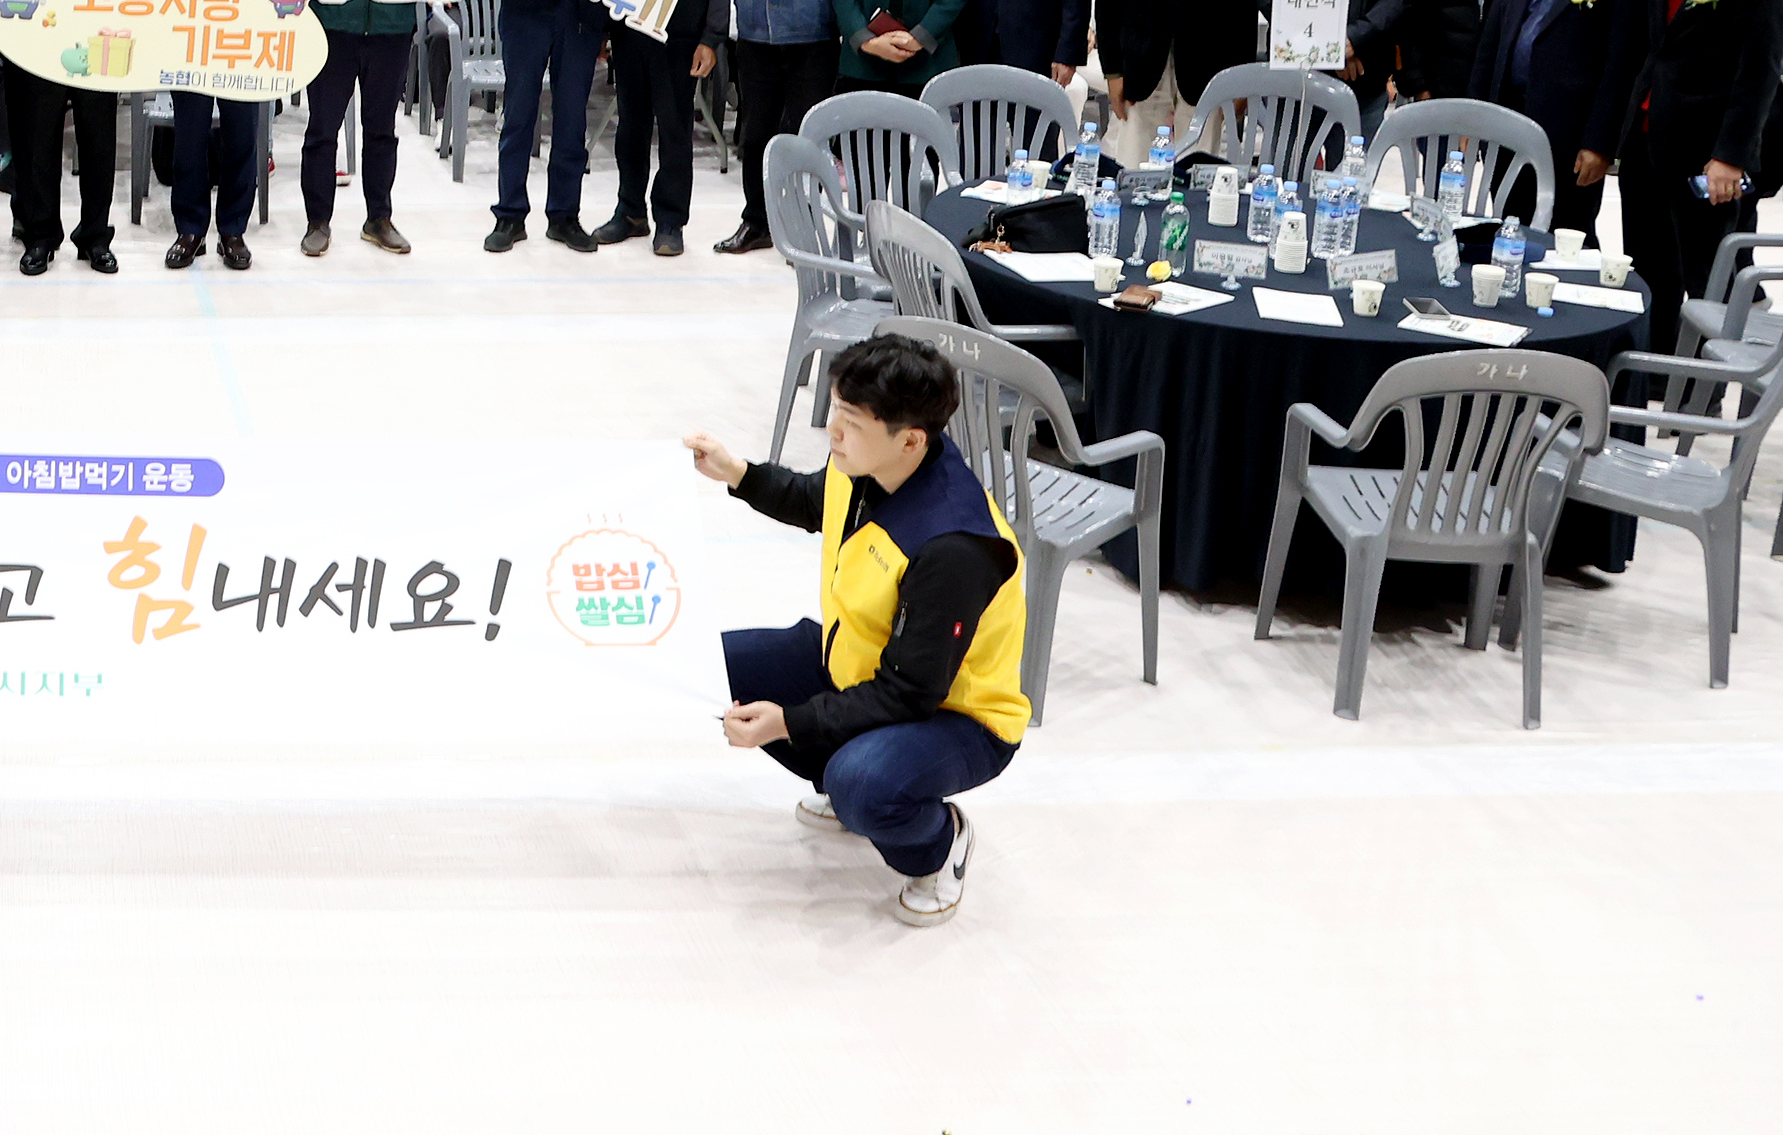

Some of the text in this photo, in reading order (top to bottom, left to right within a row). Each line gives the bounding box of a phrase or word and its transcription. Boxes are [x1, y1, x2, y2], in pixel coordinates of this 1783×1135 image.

[1303, 22, 1314, 38] 4
[172, 25, 296, 72] 기부제
[159, 69, 207, 88] 농협이
[6, 458, 134, 492] 아침밥먹기
[142, 461, 195, 492] 운동
[102, 514, 514, 645] 힘내세요!
